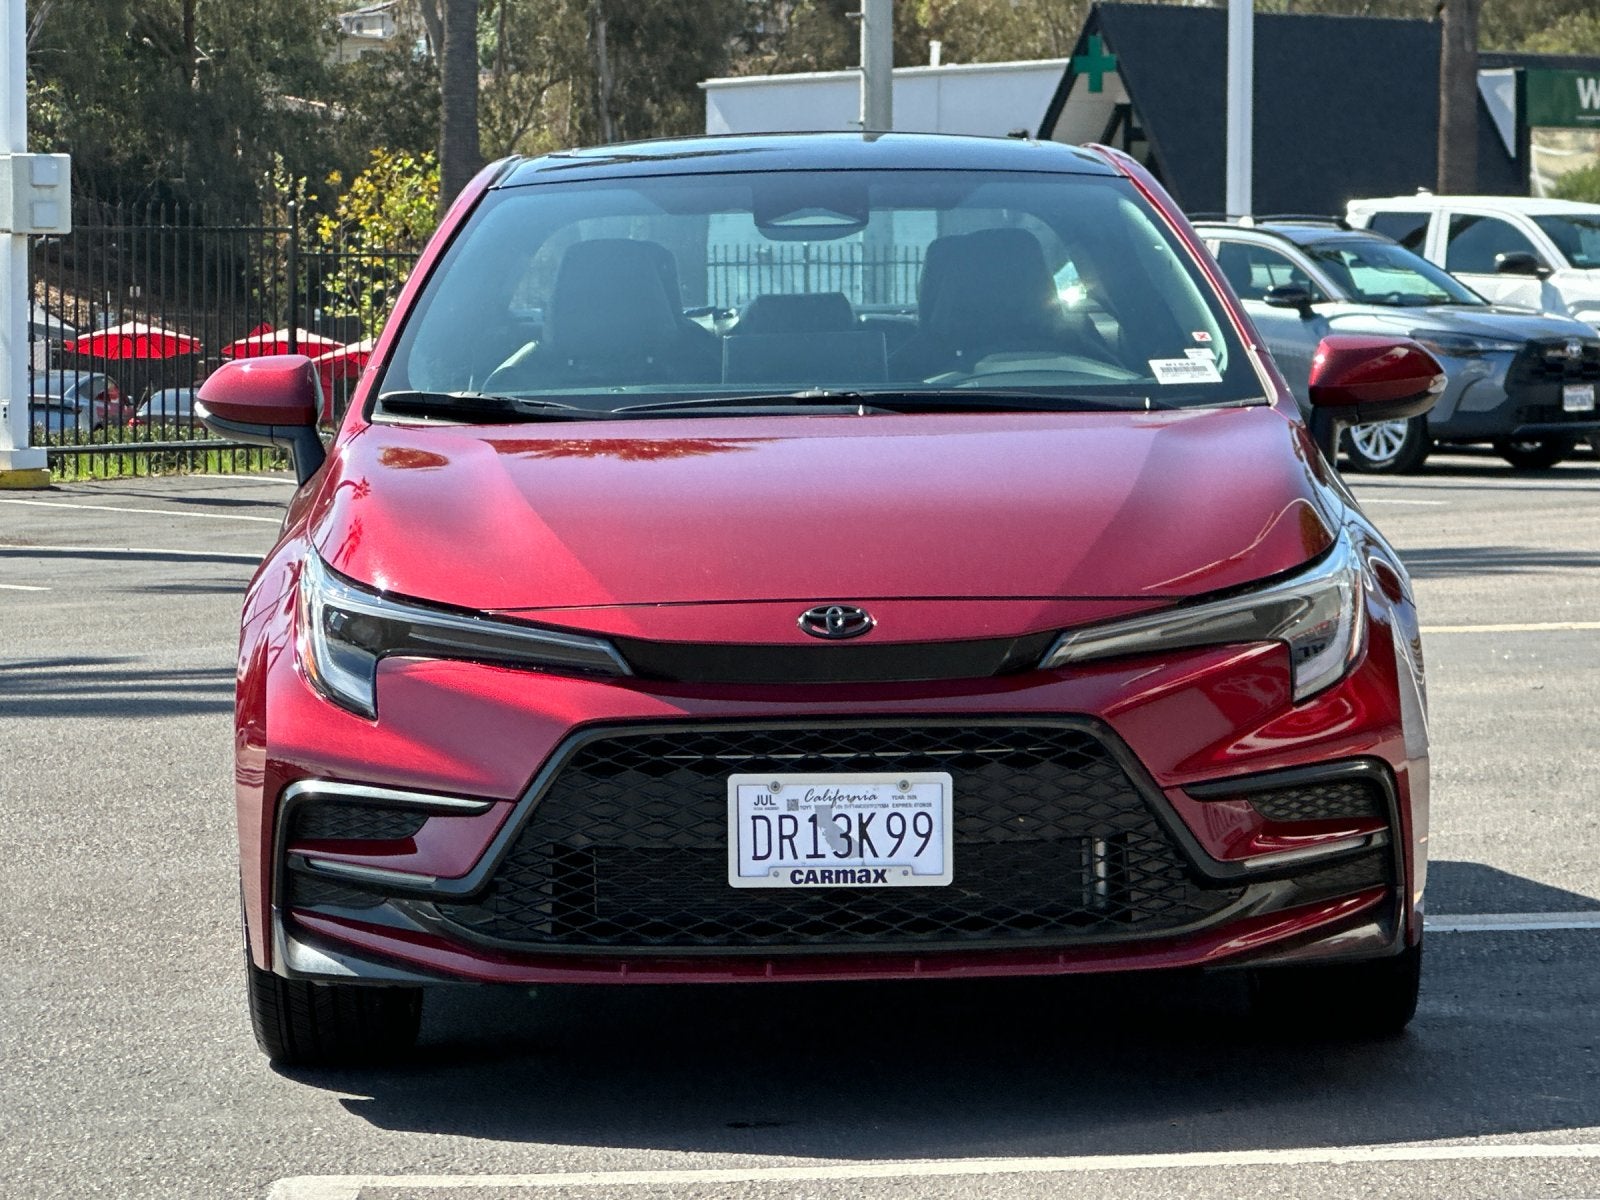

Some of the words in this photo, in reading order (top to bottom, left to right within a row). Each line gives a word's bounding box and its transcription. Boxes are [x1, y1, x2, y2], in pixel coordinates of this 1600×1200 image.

[753, 794, 776, 806] JUL
[804, 788, 878, 808] California
[751, 811, 934, 861] DR13K99
